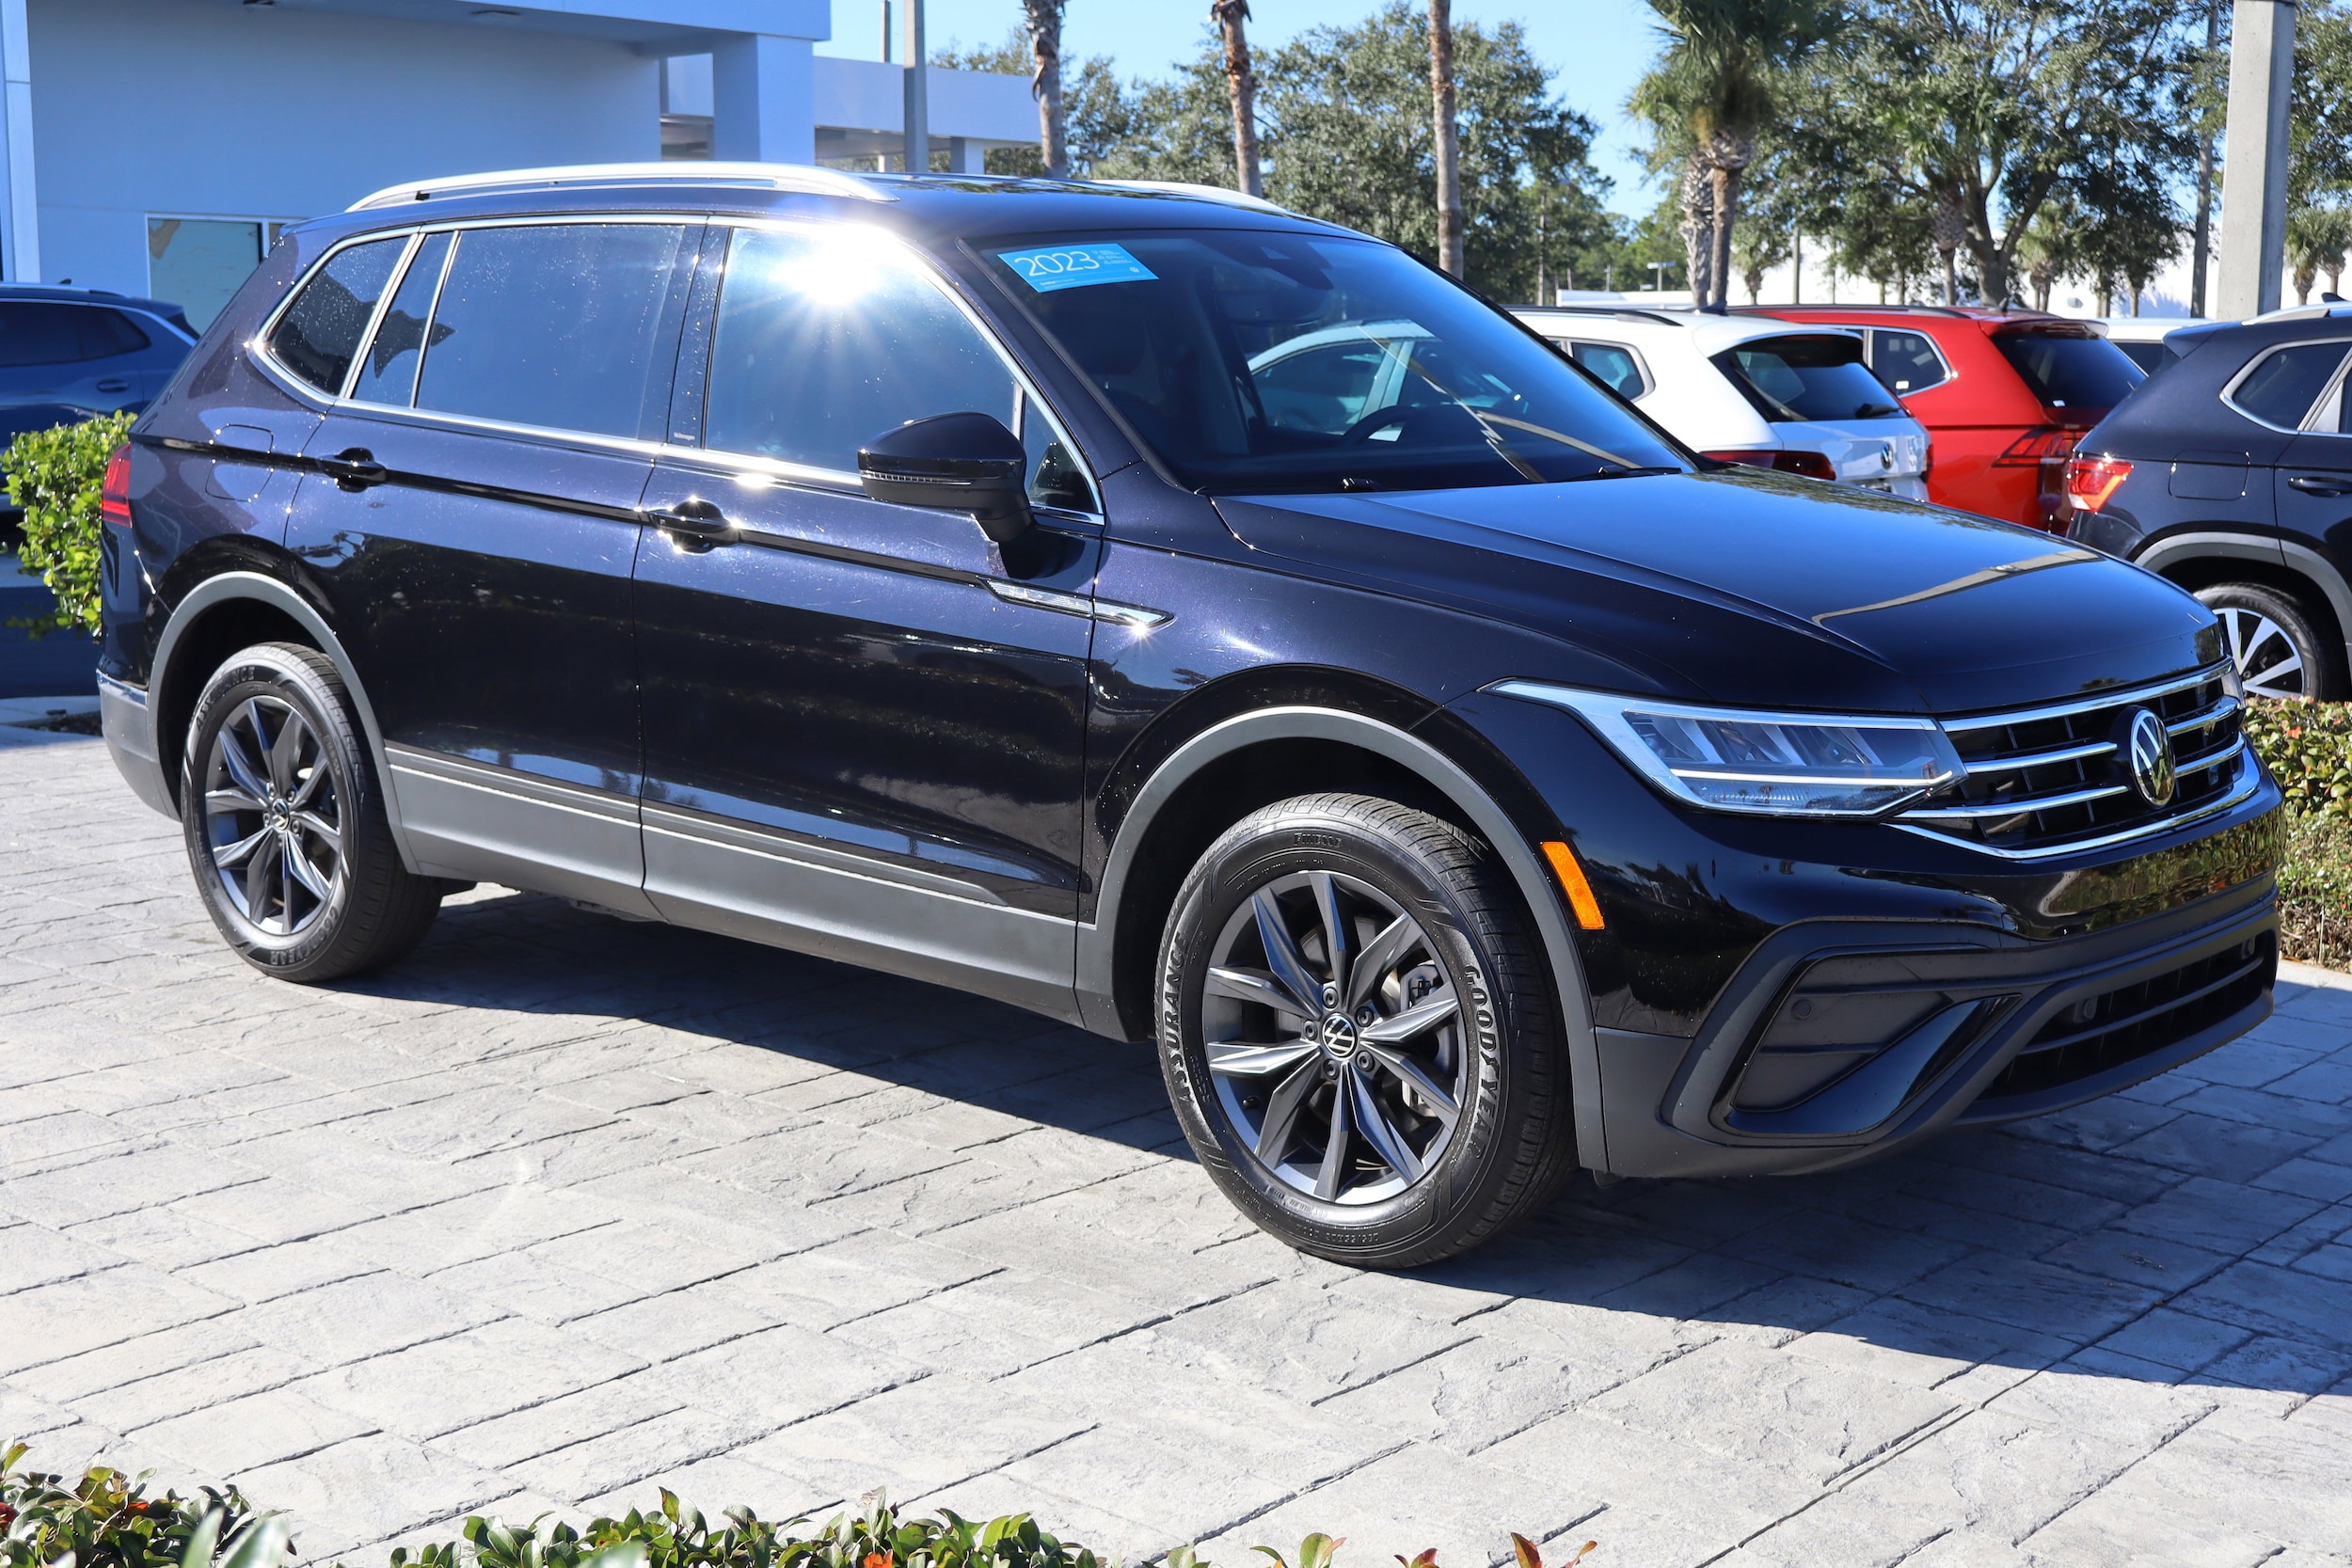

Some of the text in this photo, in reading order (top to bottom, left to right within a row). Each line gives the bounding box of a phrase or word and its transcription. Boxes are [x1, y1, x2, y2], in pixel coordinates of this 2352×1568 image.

[1014, 250, 1100, 277] 2023
[1164, 931, 1196, 1104] ASSURANCE
[1464, 965, 1501, 1160] GOODYEAR
